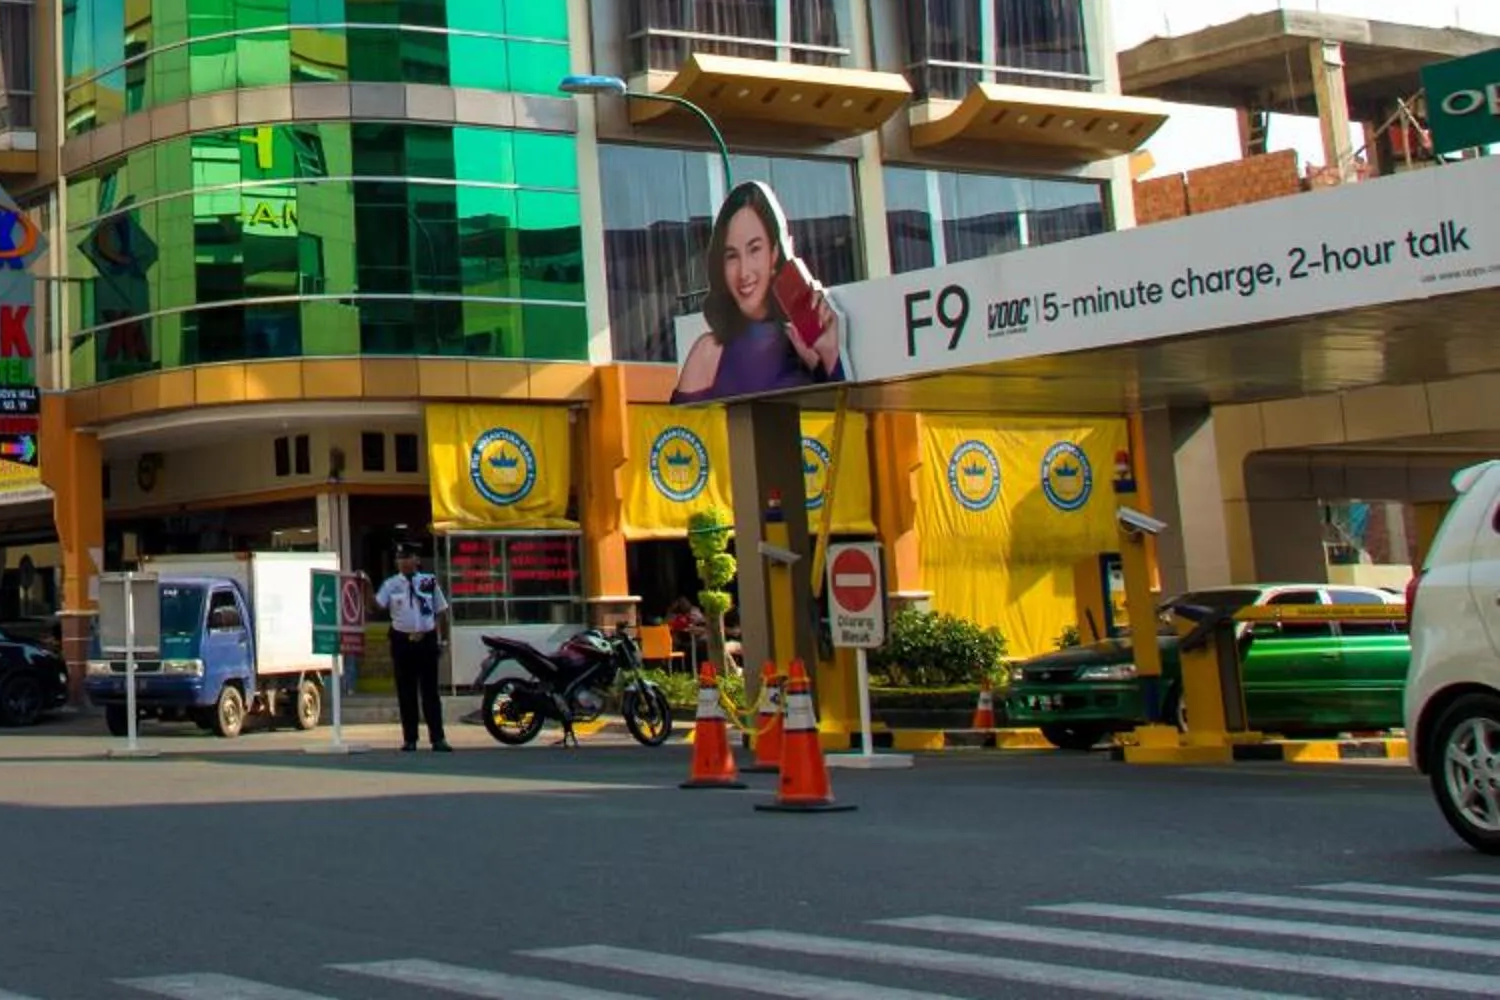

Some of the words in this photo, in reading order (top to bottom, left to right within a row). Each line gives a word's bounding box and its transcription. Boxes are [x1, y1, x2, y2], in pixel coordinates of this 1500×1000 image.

[1044, 281, 1164, 322] 5-minute
[1171, 262, 1282, 297] charge,
[1288, 240, 1396, 280] 2-hour
[1404, 219, 1471, 259] talk
[904, 284, 970, 357] F9
[987, 297, 1031, 331] VOOC
